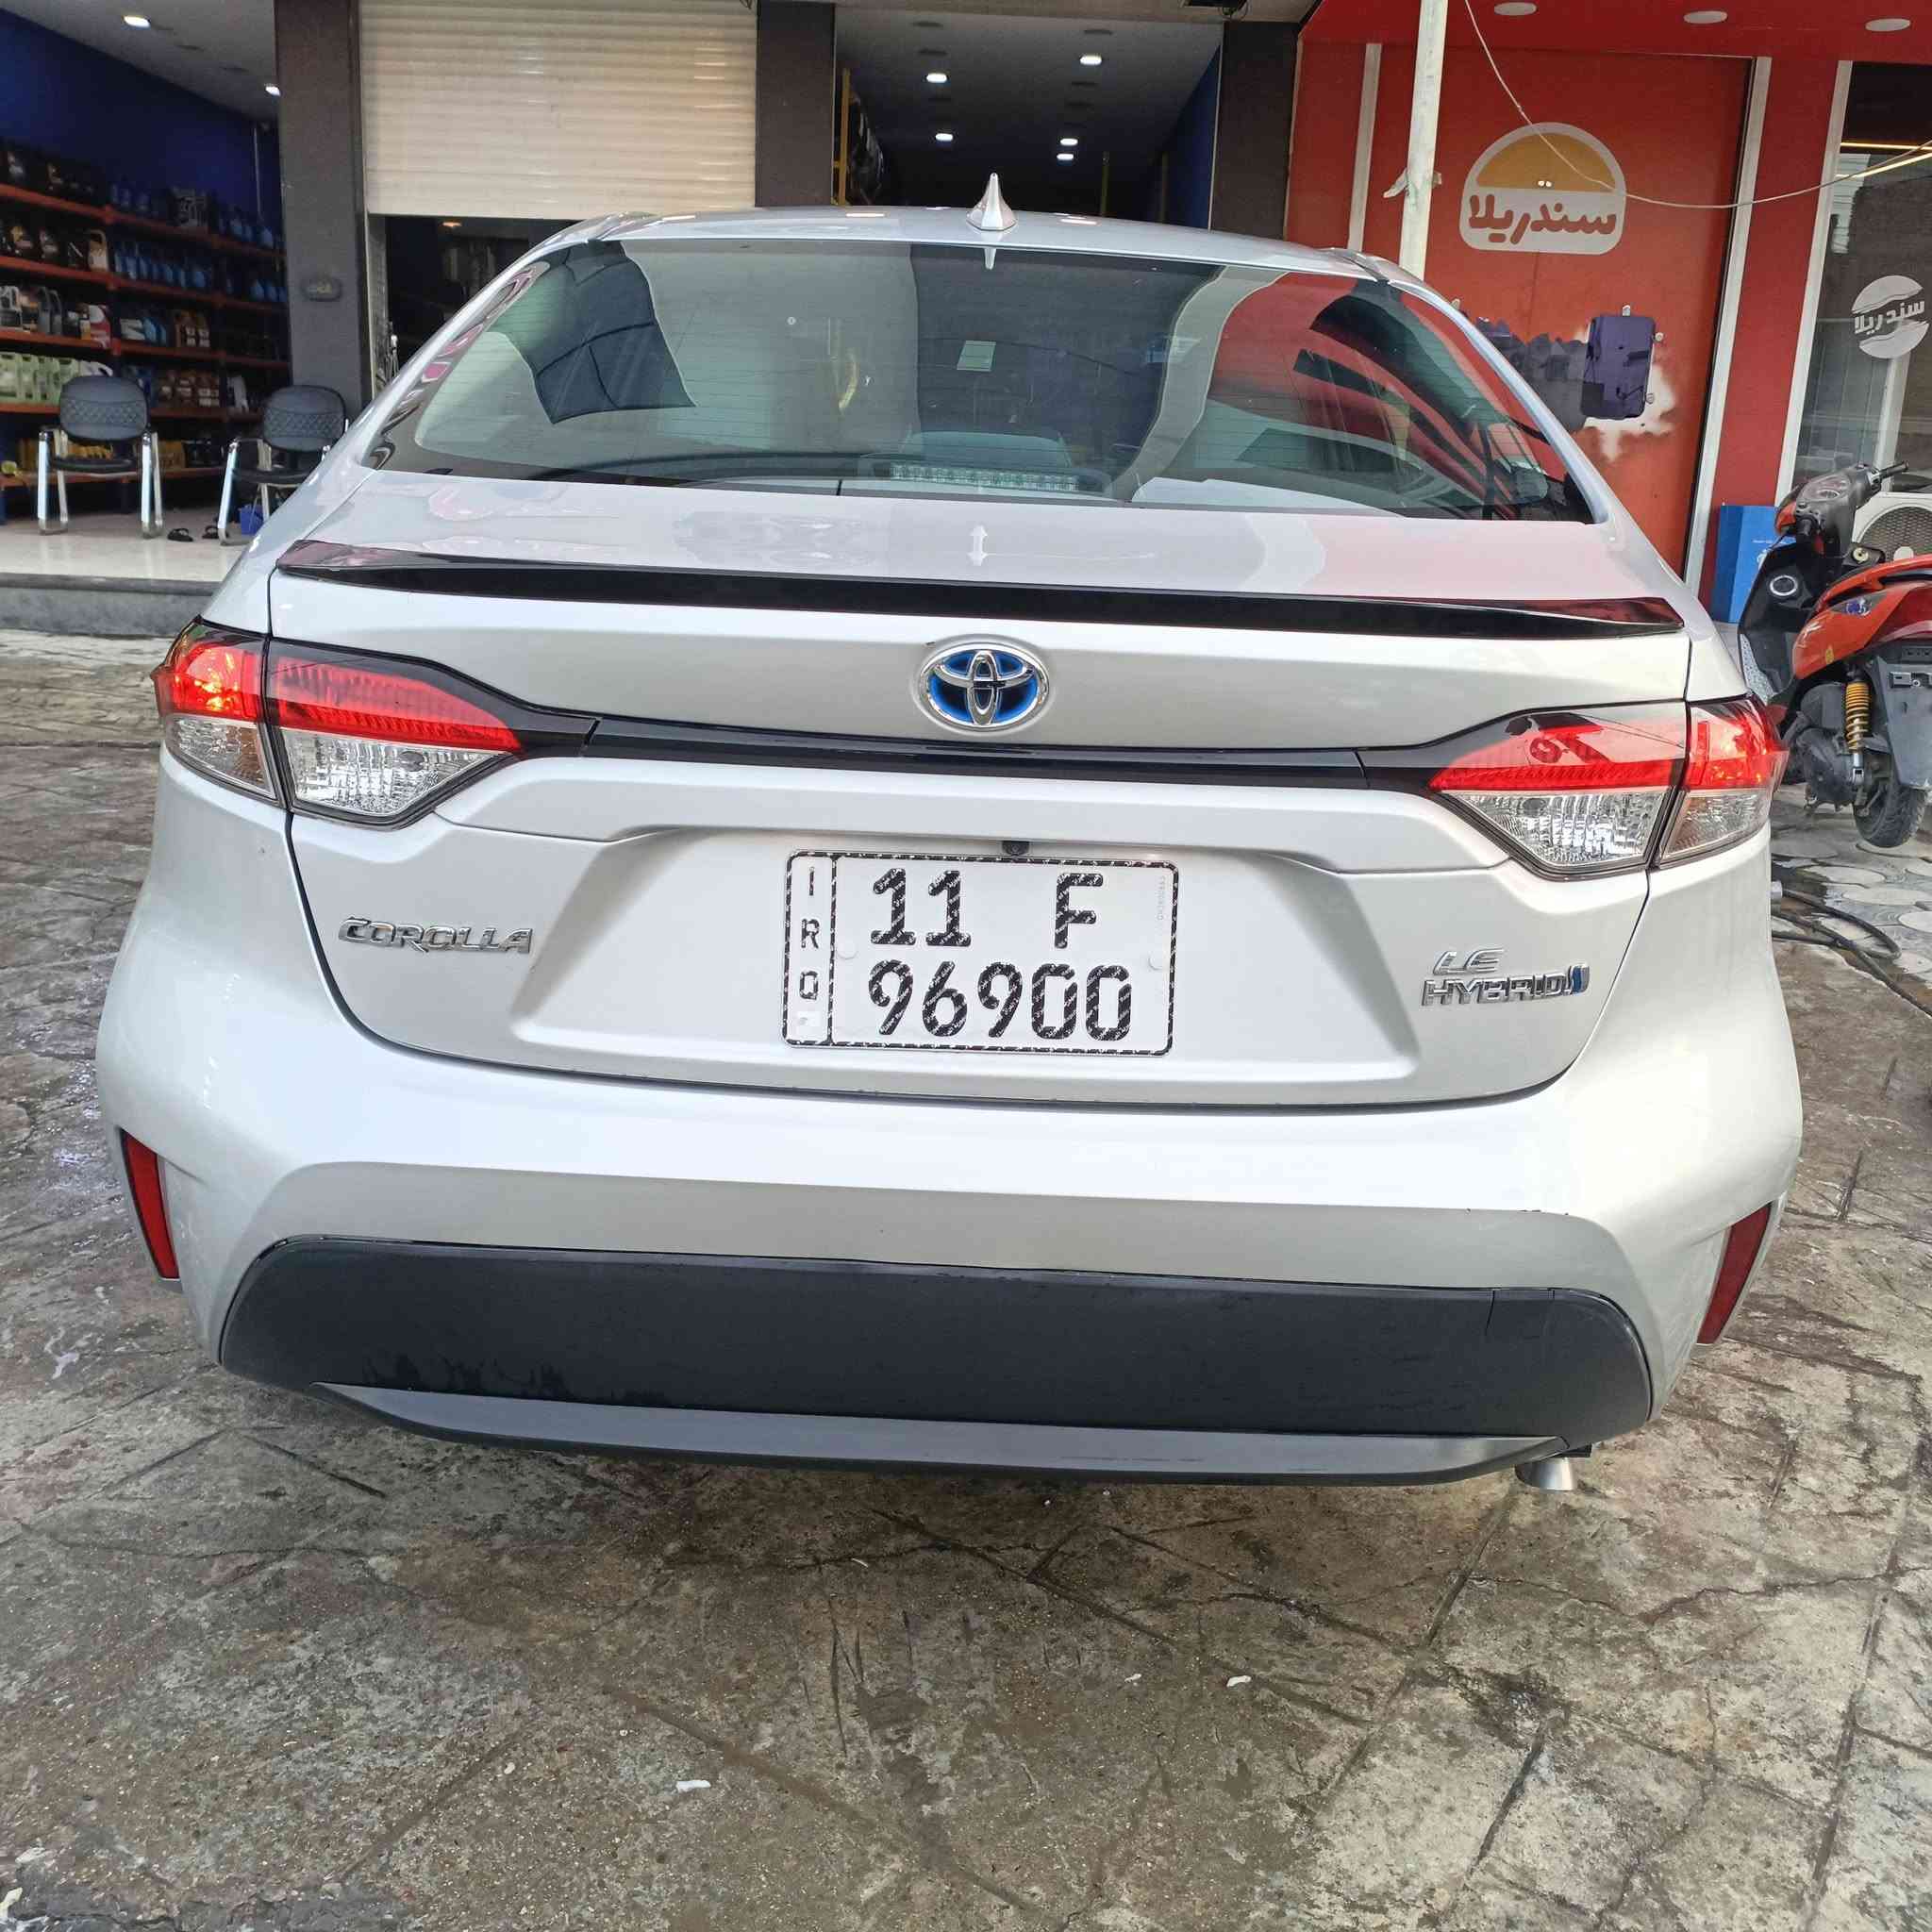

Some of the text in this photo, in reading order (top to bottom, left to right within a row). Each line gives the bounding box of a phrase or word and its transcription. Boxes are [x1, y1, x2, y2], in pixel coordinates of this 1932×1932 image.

[1469, 194, 1616, 244] سندريلا
[1855, 301, 1925, 335] سندريلا
[870, 867, 972, 947] 11
[1054, 873, 1104, 948] F
[339, 916, 533, 953] COROLLA
[1433, 948, 1504, 975] LE
[868, 959, 1132, 1041] 96900
[1422, 972, 1574, 1007] HYBRID
